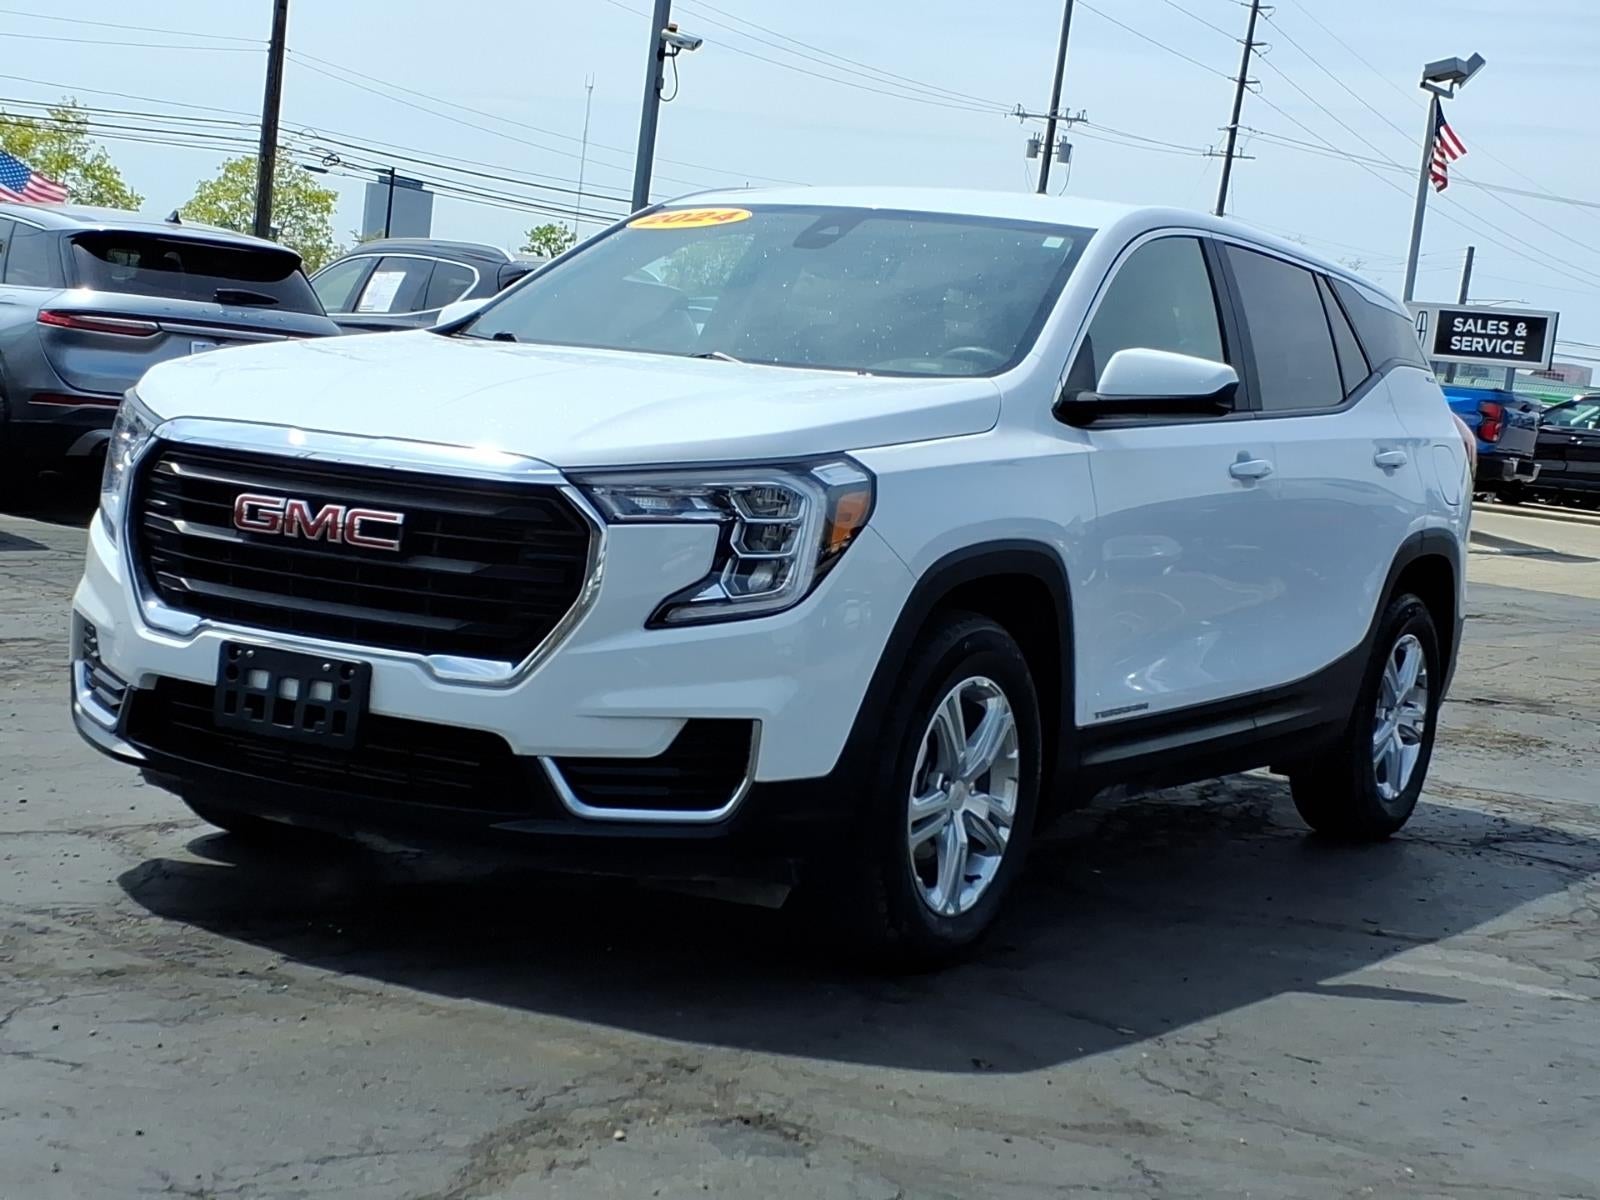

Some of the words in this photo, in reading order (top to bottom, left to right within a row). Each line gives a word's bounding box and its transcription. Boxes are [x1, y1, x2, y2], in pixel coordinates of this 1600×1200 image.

[636, 211, 744, 225] 2024
[1452, 317, 1509, 335] SALES
[1514, 322, 1528, 337] &
[1450, 336, 1526, 355] SERVICE
[233, 493, 405, 551] GMC
